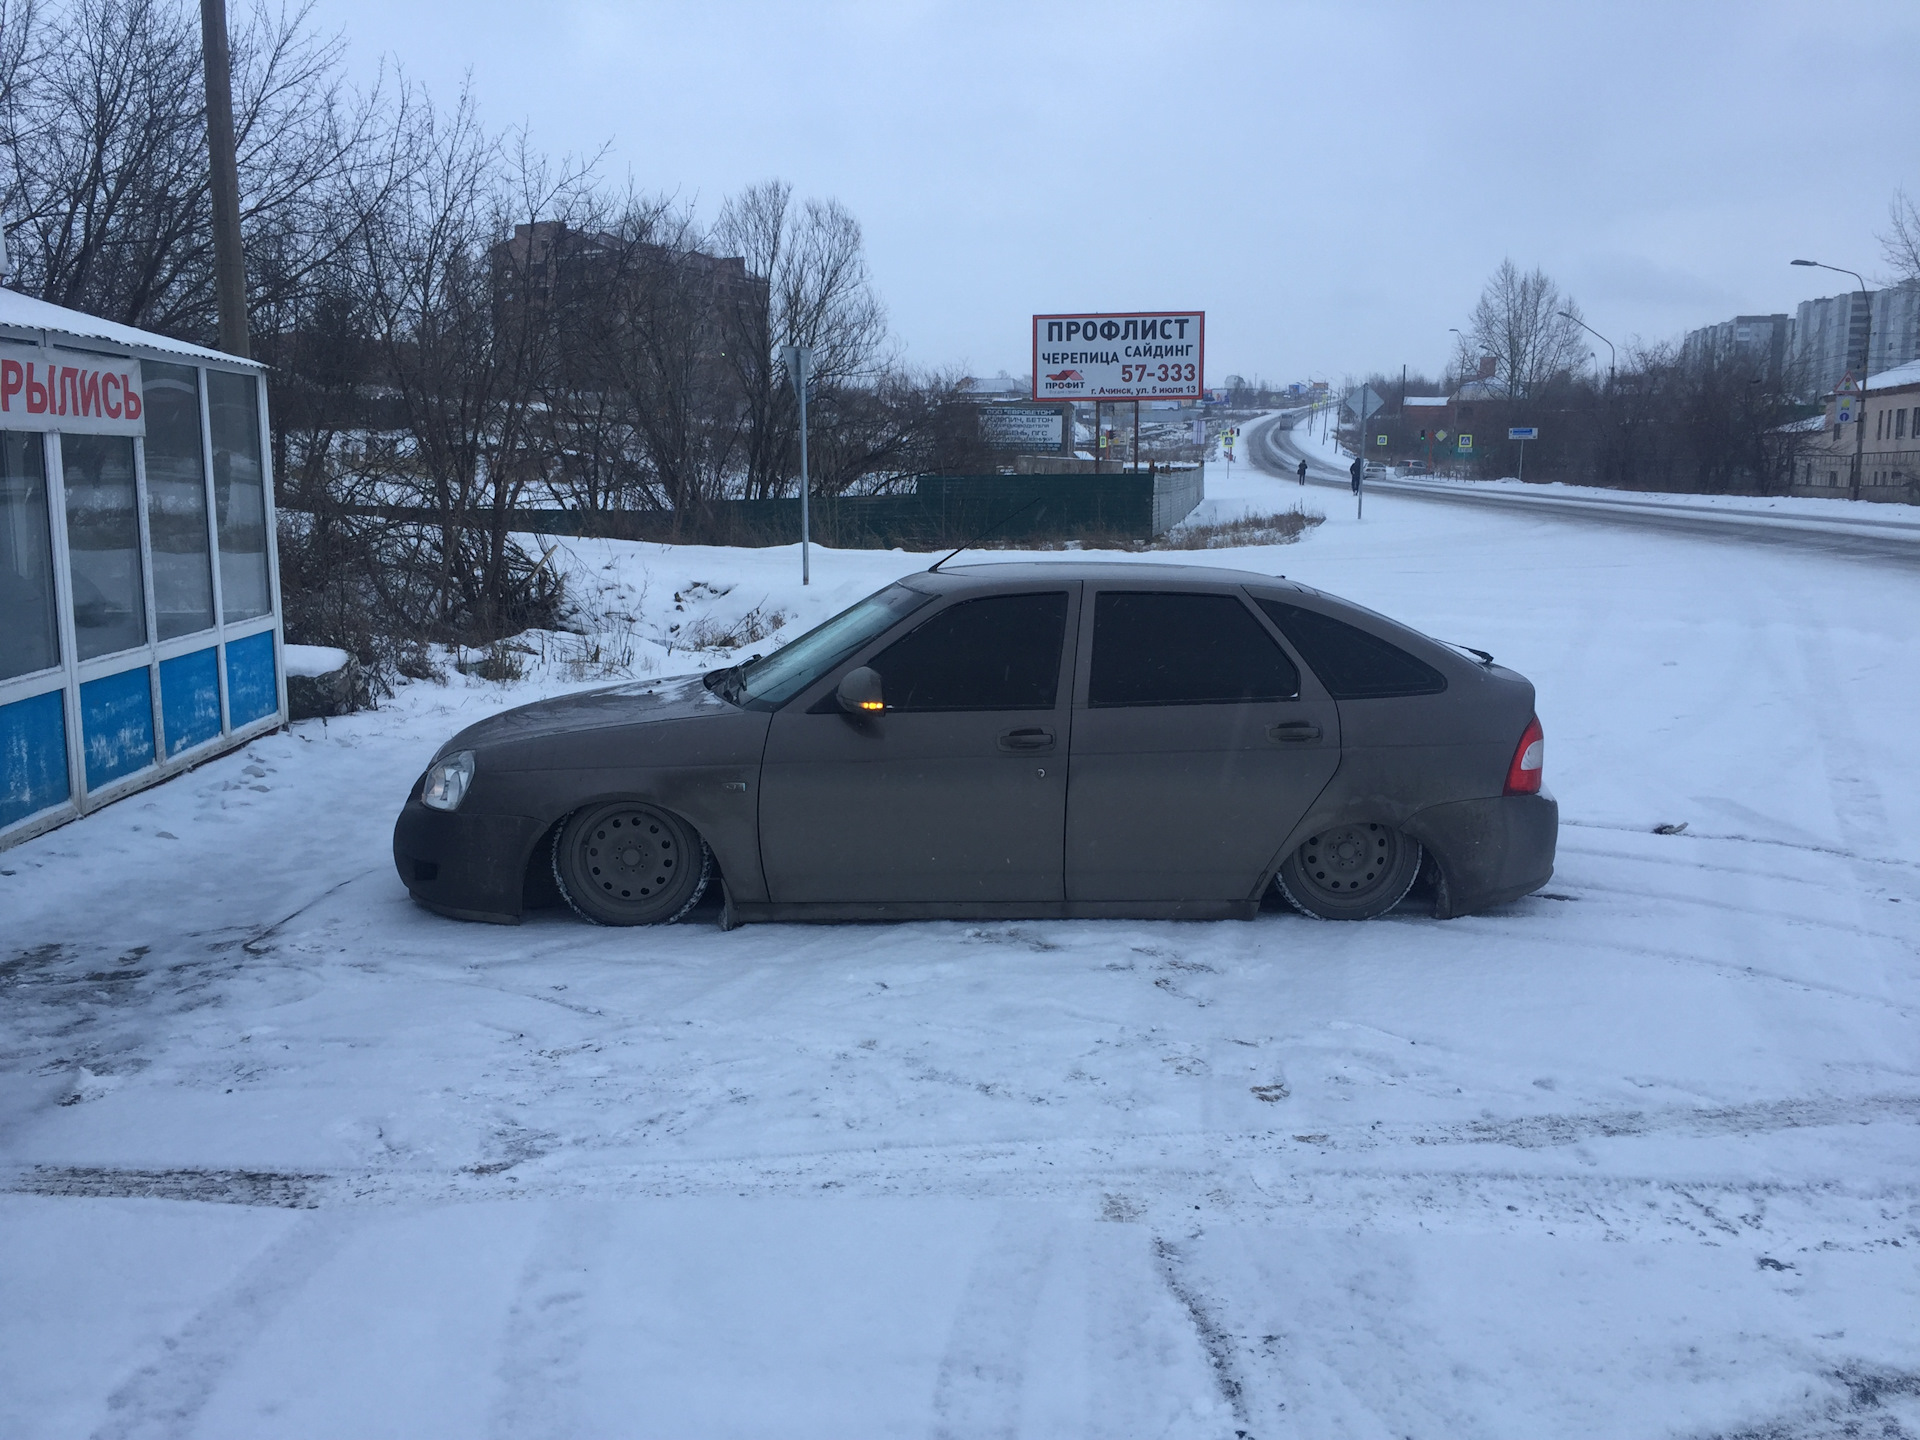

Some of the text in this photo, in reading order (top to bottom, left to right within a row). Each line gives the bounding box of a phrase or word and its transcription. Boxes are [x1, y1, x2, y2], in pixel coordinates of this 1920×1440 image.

[1047, 318, 1190, 342] ПРОФЛИСТ
[1042, 351, 1120, 365] ЧЕРЕПИЦА
[1124, 344, 1194, 359] САЙДИНГ
[1121, 363, 1196, 383] 57-333
[1, 359, 142, 420] РЫЛИСЬ
[1045, 381, 1085, 390] ПРОФИТ
[1098, 387, 1134, 396] Ачинск,
[1136, 388, 1150, 396] ул.
[1151, 386, 1157, 394] 5
[1159, 386, 1183, 394] июля
